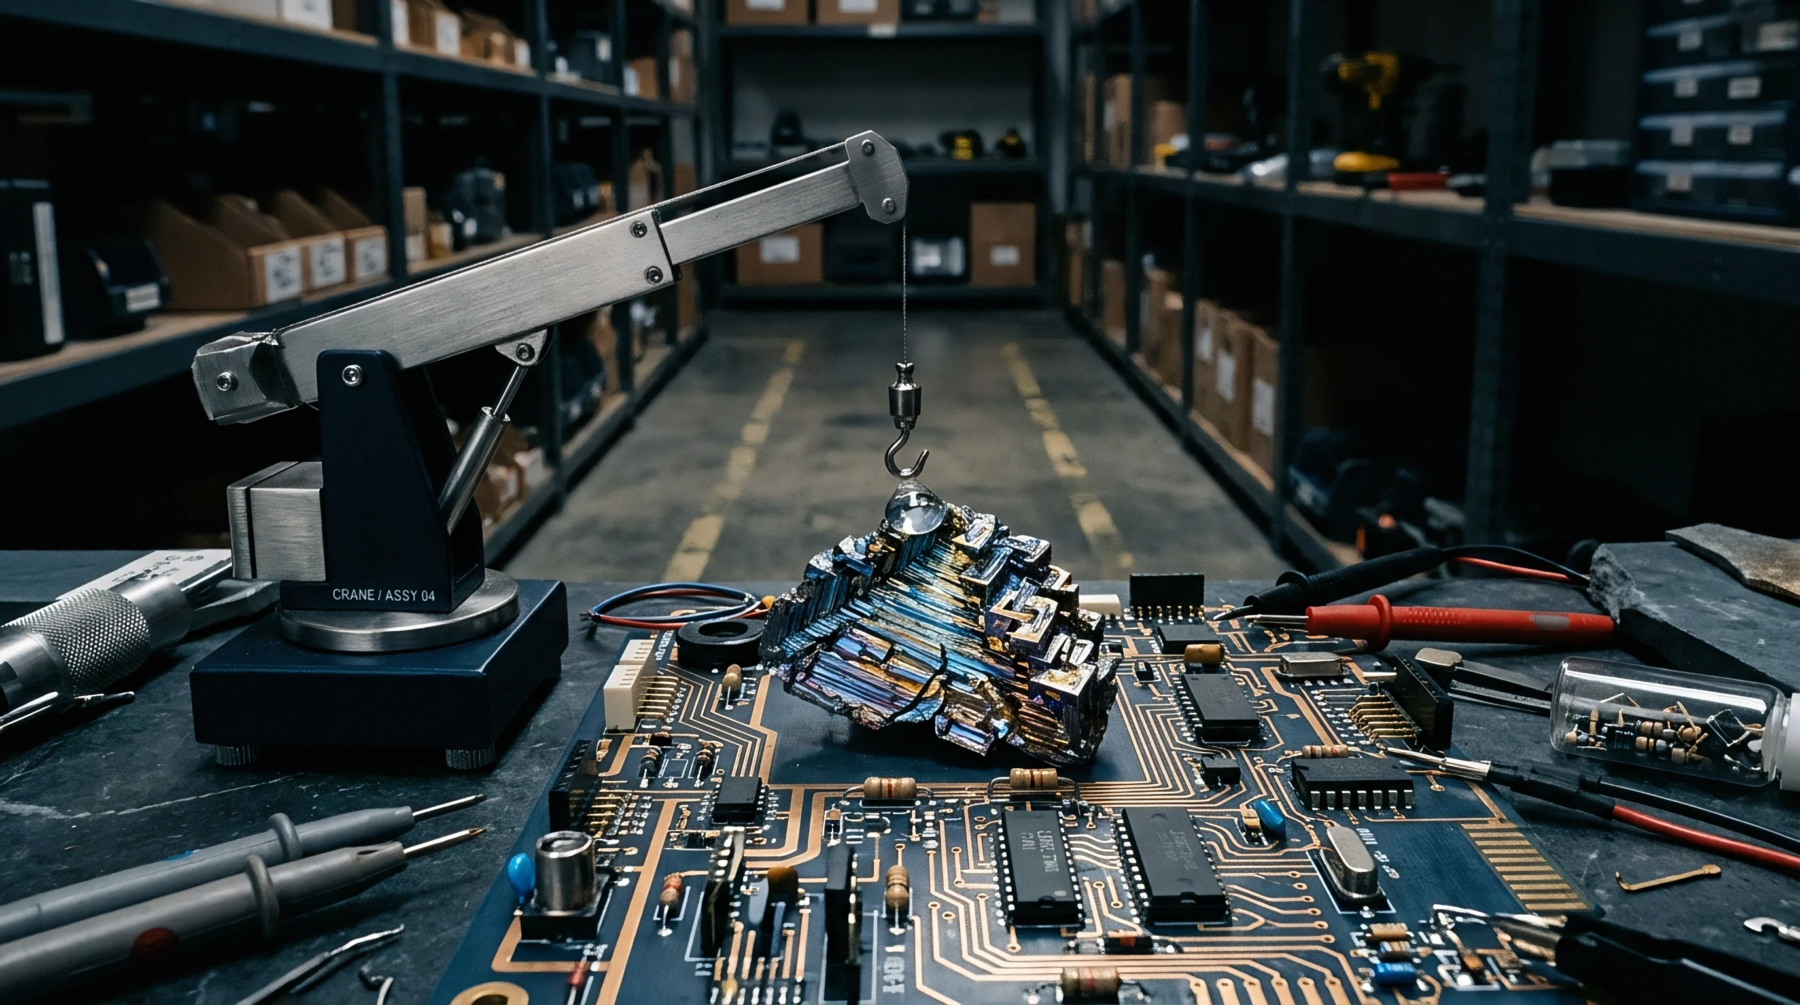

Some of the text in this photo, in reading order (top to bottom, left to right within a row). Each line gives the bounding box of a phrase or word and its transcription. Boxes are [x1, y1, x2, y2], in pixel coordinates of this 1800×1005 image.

[332, 588, 436, 602] CRANE / ASSY 04
